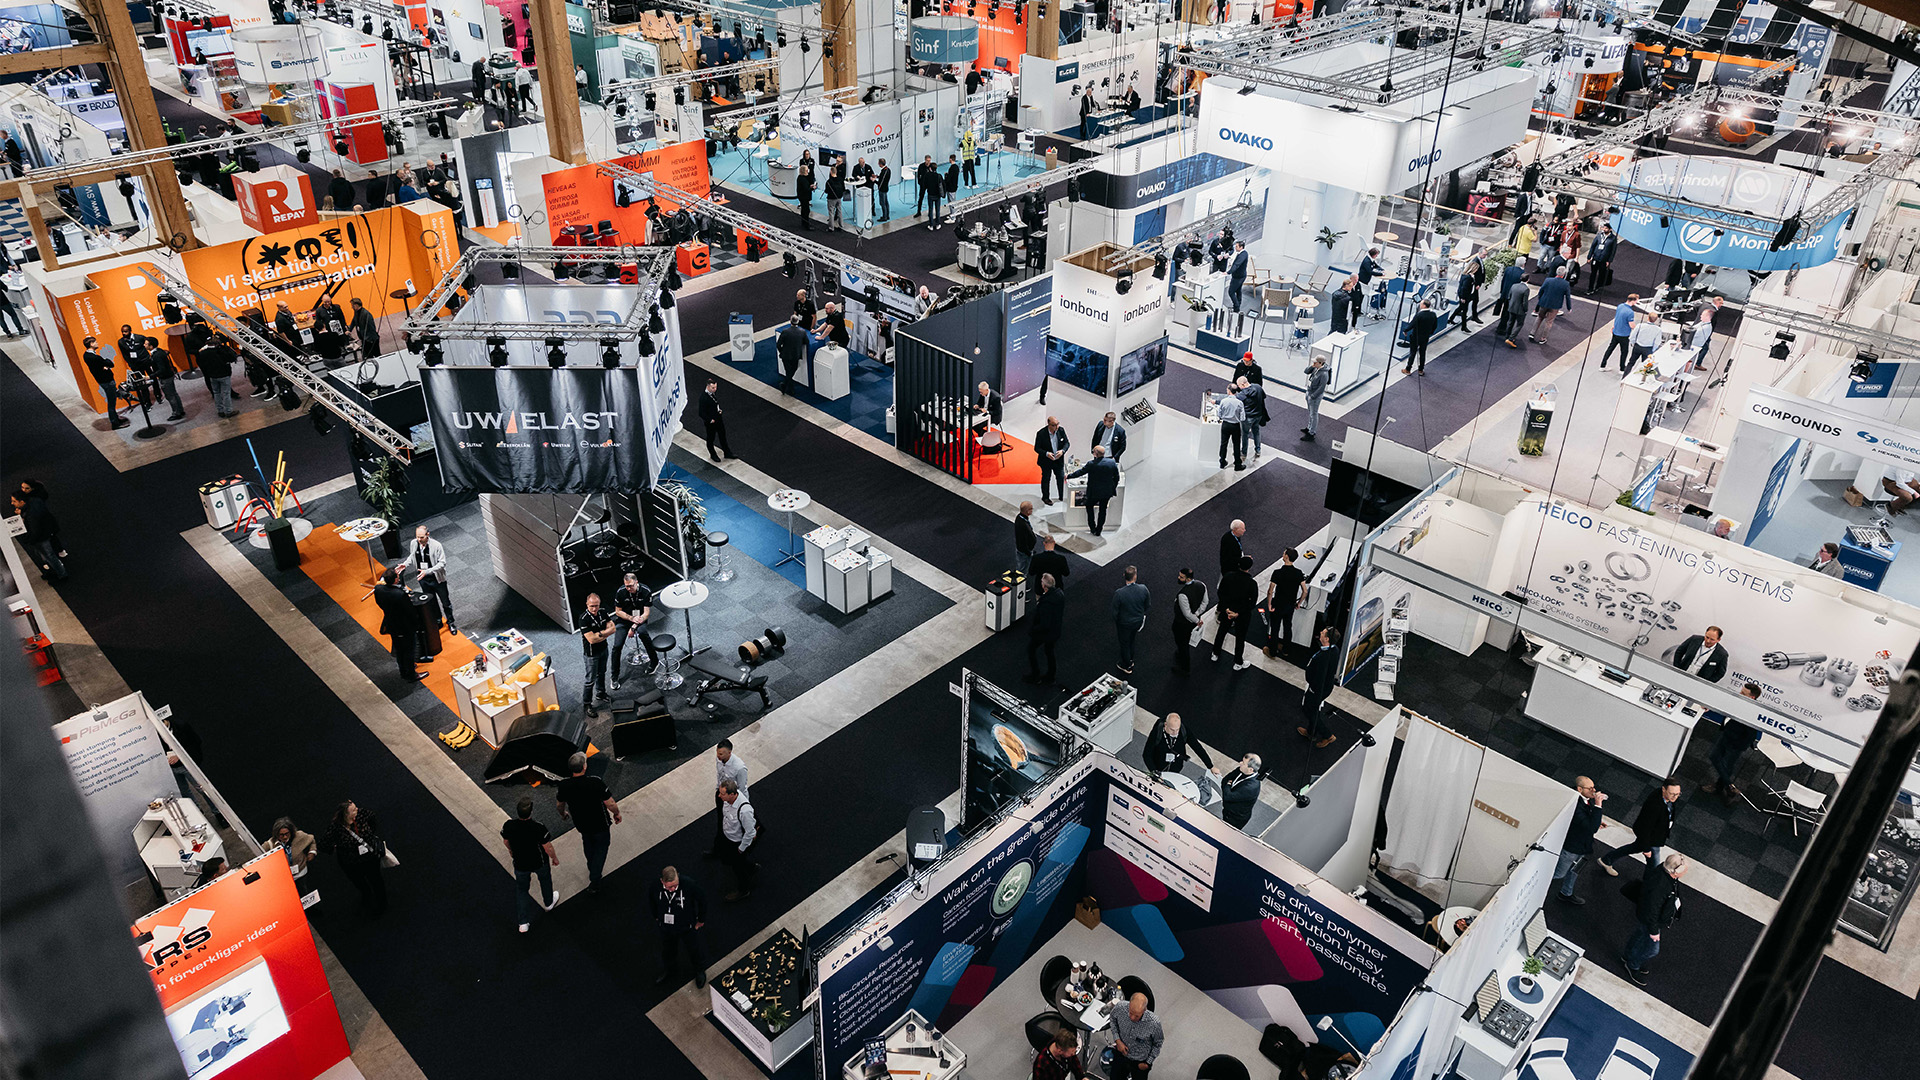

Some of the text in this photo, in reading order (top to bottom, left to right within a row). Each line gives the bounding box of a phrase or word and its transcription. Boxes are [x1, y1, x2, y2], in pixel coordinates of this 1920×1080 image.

[915, 38, 939, 54] Sinf
[683, 105, 698, 114] Sinf
[851, 138, 876, 151] FRISTAD
[877, 133, 895, 144] PLAST
[878, 144, 889, 153] 1967
[1219, 127, 1273, 151] OVAKO
[596, 155, 660, 179] FOGUMMI
[670, 157, 687, 166] HEVEA
[672, 165, 697, 175] VINTROSA
[548, 182, 576, 194] HEVEA AS
[672, 173, 691, 181] GUMMI
[1136, 181, 1166, 198] OVAKO
[549, 193, 578, 204] VINTROSA
[550, 201, 570, 211] GUMMI
[273, 210, 306, 223] REPAY
[552, 213, 590, 227] INSTRUMENT
[561, 209, 581, 219] VASAR
[1631, 211, 1653, 225] ERP
[1796, 234, 1824, 250] ERP
[216, 248, 350, 291] Vi skär tid och
[222, 262, 375, 310] kapar frustration
[1011, 287, 1032, 301] ionbond
[1087, 288, 1097, 296] IHI
[73, 300, 90, 334] Gemensam
[83, 297, 102, 335] Lokal närhet
[1060, 295, 1109, 322] ionbond
[1123, 295, 1161, 323] ionbond
[1752, 404, 1842, 437] COMPOUNDS
[1878, 449, 1902, 460] HEXPOL
[1412, 504, 1429, 521] HEICO
[1538, 500, 1794, 604] HEICO FASTENING SYSTEMS
[1472, 594, 1503, 612] HEICO
[1541, 603, 1574, 620] LOCKING
[1575, 615, 1609, 634] SYSTEMS
[1730, 678, 1781, 705] TENNING
[1782, 700, 1823, 721] SYSTEMS
[79, 708, 137, 738] PlaMeGa
[1757, 713, 1796, 735] HEICO
[67, 749, 85, 759] Metal
[118, 724, 142, 738] welding
[69, 741, 116, 764] and processing
[72, 735, 147, 771] Plastic injection molding
[75, 757, 117, 778] Tube bending
[78, 753, 144, 784] Welded constructions
[81, 751, 163, 791] Tool design and production
[1055, 763, 1093, 796] ALBIS
[84, 770, 139, 798] Surface treatment
[1117, 772, 1164, 802] ALBIS
[942, 880, 969, 905] Walk
[970, 867, 985, 883] on
[986, 850, 1005, 869] the
[1059, 796, 1071, 811] of
[1072, 785, 1088, 802] life.
[1264, 878, 1388, 962] We drive polymer
[143, 925, 213, 968] RS
[840, 922, 889, 965] ALBIS
[1261, 894, 1385, 979] distribution. Easy,
[169, 920, 279, 986] förverkligar idéer
[1259, 907, 1389, 996] smart, passionate.
[838, 966, 878, 1002] Bio-Circular
[878, 939, 915, 970] Resources
[838, 956, 904, 1010] Chemical Recycling
[839, 956, 913, 1019] Closed Loop Recycling
[840, 984, 892, 1027] Post-Consumer
[892, 956, 924, 986] Recycling
[840, 969, 920, 1036] Post-Industrial Recycling
[840, 983, 913, 1045] Renewable Resources
